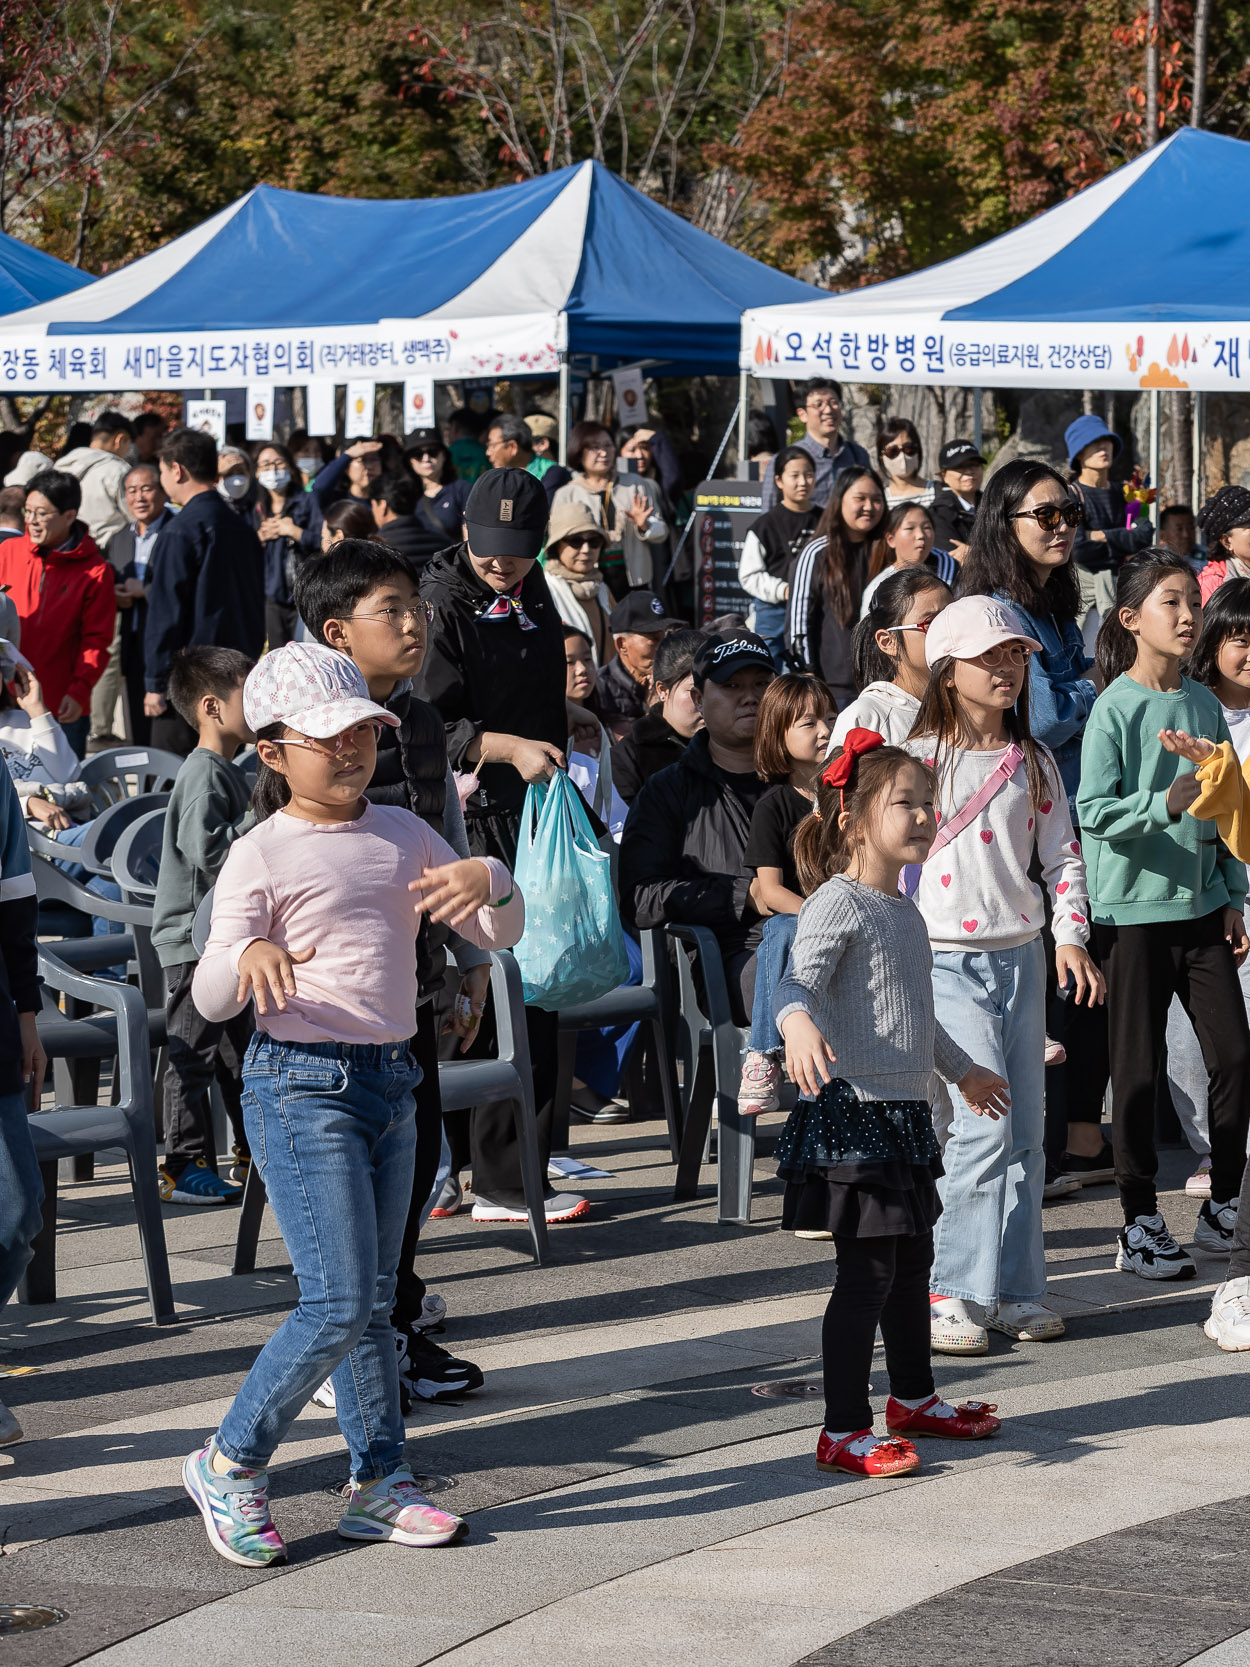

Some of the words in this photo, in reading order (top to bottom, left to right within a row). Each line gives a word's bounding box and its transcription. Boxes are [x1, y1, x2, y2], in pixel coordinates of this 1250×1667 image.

[0, 348, 40, 381] 장동
[49, 347, 107, 380] 체육회
[124, 340, 315, 379] 새마을지도자협의회
[402, 338, 451, 365] 생맥주)
[785, 331, 945, 374] 오석한방병원
[1048, 343, 1113, 370] 건강상담)
[984, 606, 1007, 628] NY
[712, 638, 769, 663] Titleist
[318, 657, 358, 691] NY
